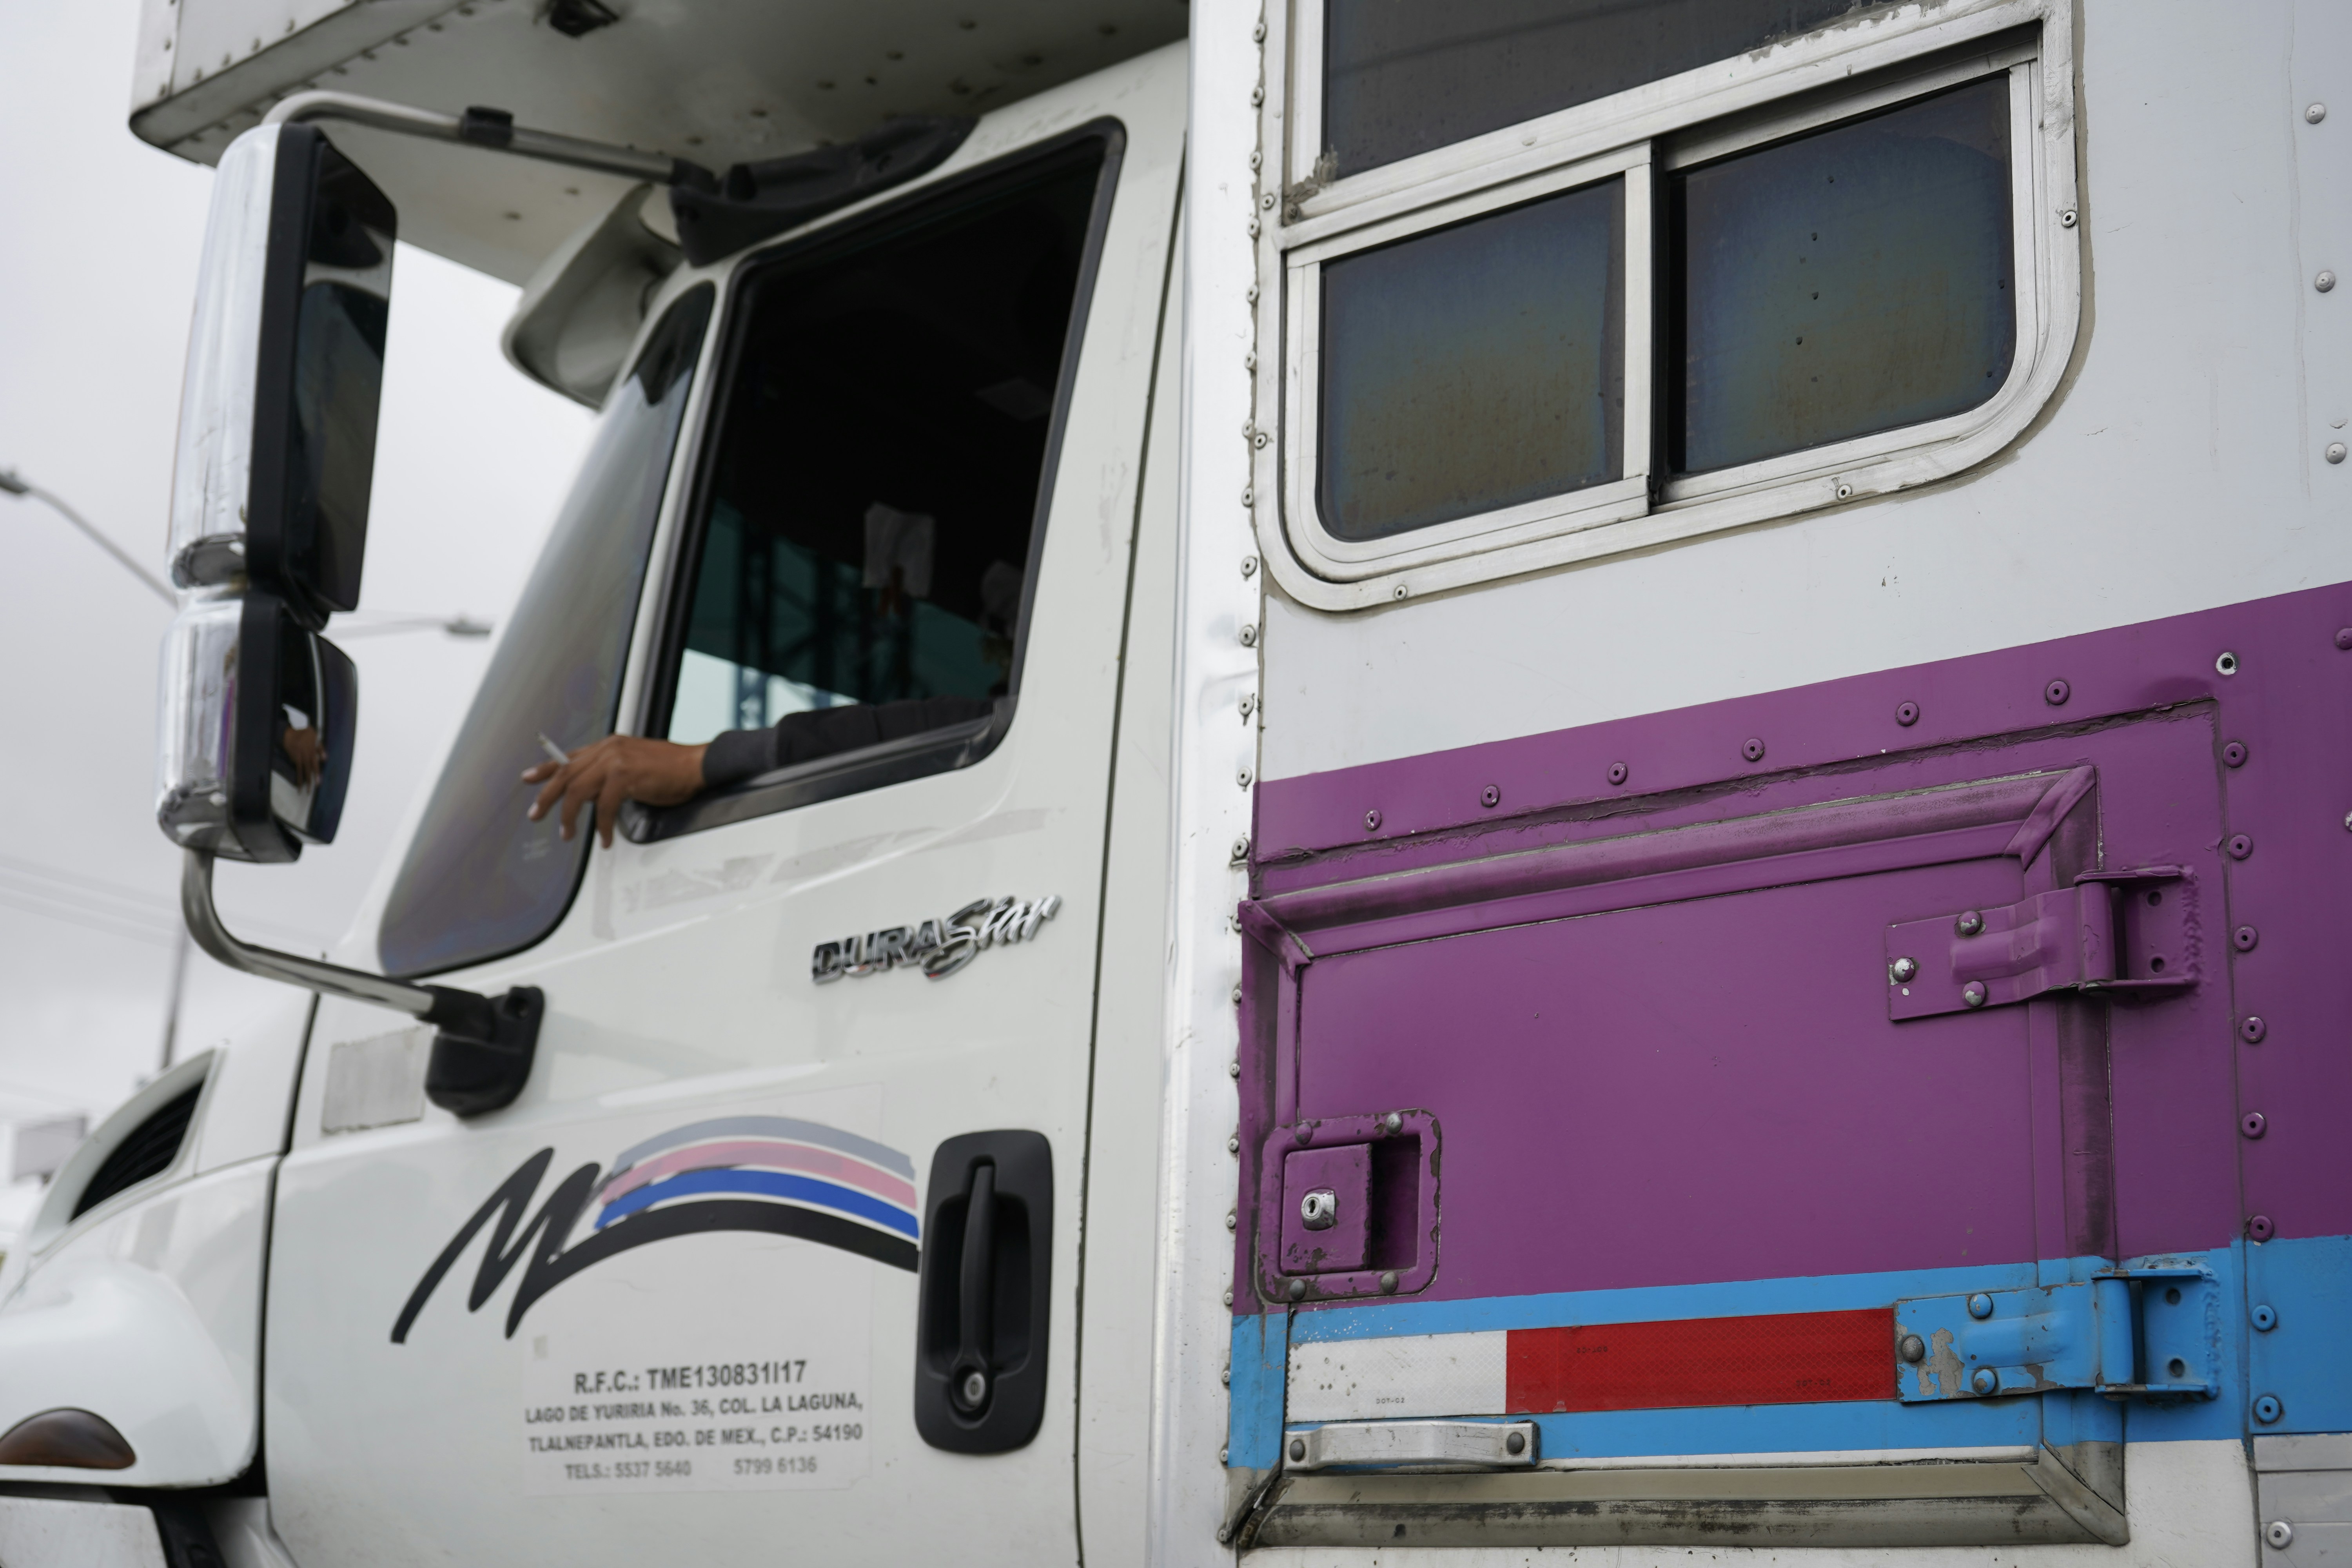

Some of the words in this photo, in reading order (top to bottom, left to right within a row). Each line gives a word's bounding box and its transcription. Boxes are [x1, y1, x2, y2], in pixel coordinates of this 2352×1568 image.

[574, 1371, 640, 1394] R.F.C.:
[525, 1406, 565, 1424] LAGO
[568, 1405, 589, 1421] DE
[660, 1401, 686, 1417] No.
[720, 1398, 757, 1414] COL.
[762, 1396, 782, 1412] LA
[788, 1392, 863, 1411] LAGUNA,
[528, 1432, 649, 1452] TLALNEPANTLA,
[654, 1430, 690, 1447] EDO.
[695, 1430, 715, 1446] DE
[812, 1423, 863, 1441] 54190
